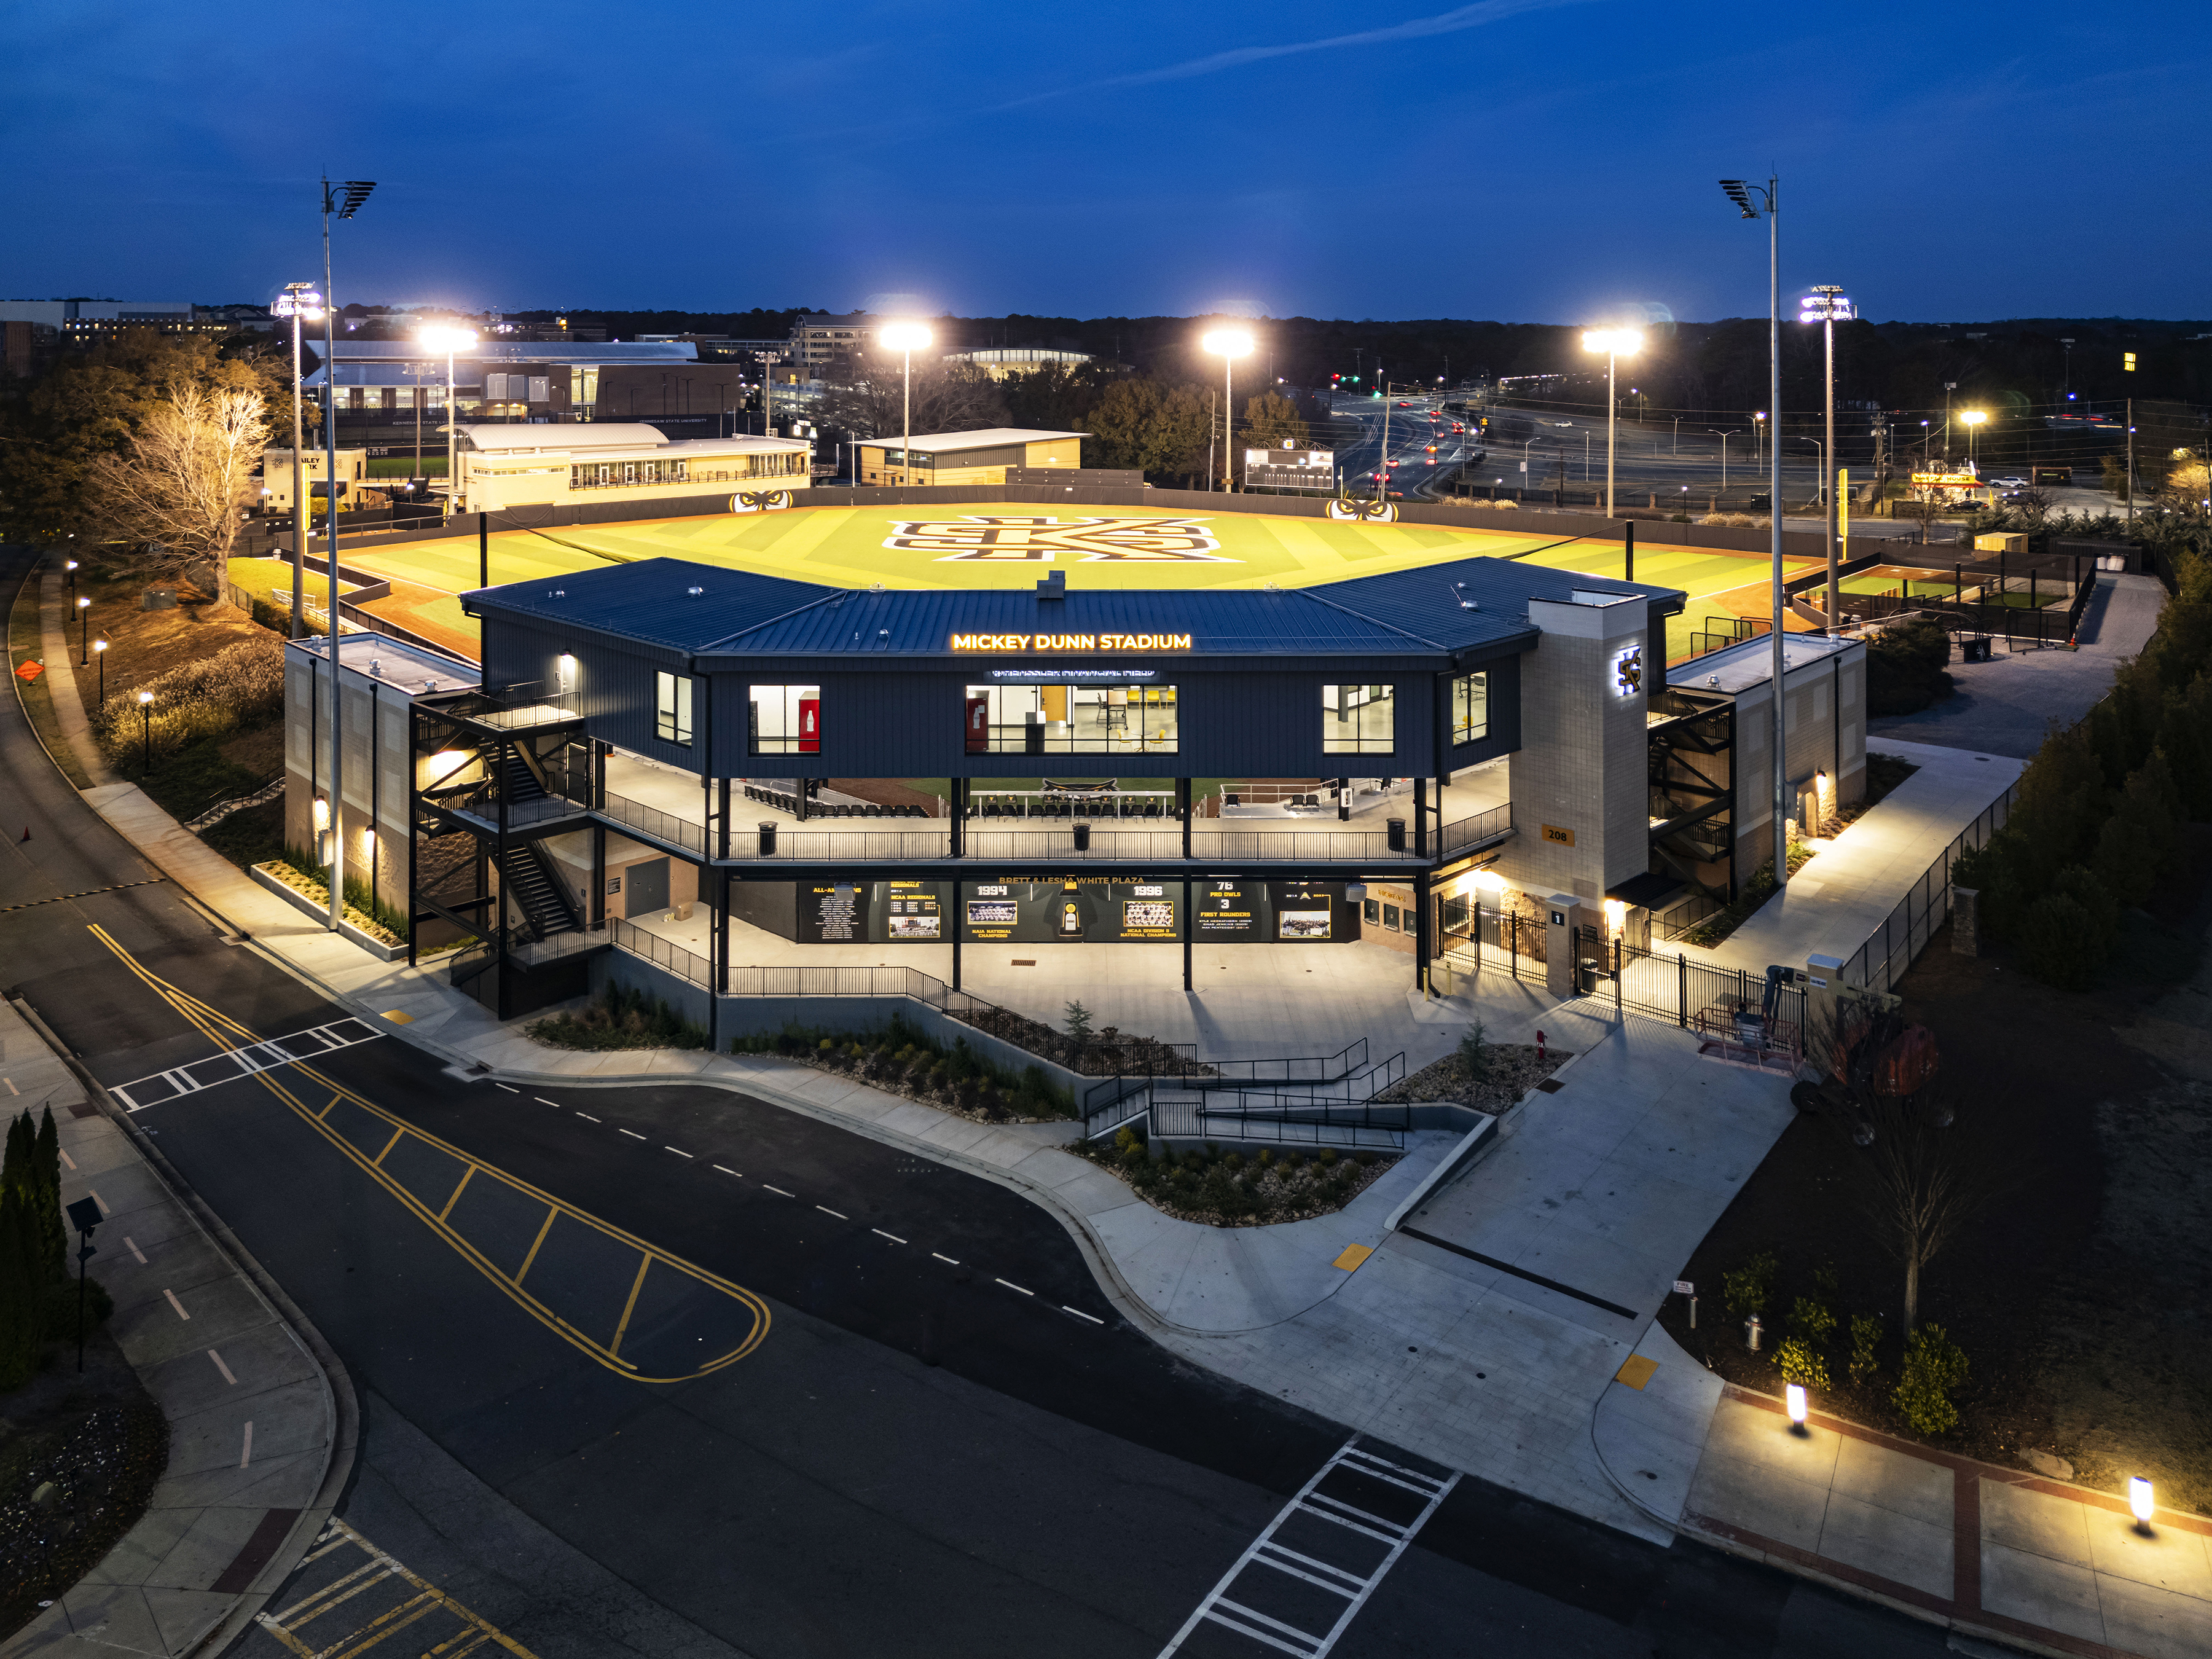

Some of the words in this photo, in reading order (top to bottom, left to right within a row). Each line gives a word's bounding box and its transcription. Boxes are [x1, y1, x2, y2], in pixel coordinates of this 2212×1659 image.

[954, 635, 1030, 649] MICKEY
[1036, 635, 1095, 649] DUNN
[1100, 635, 1191, 649] STADIUM
[1548, 830, 1567, 842] 208
[977, 885, 1007, 895] 1994
[1134, 886, 1163, 896] 1996
[1217, 882, 1233, 890] 76
[1221, 899, 1230, 909] 3
[1555, 915, 1560, 924] 1
